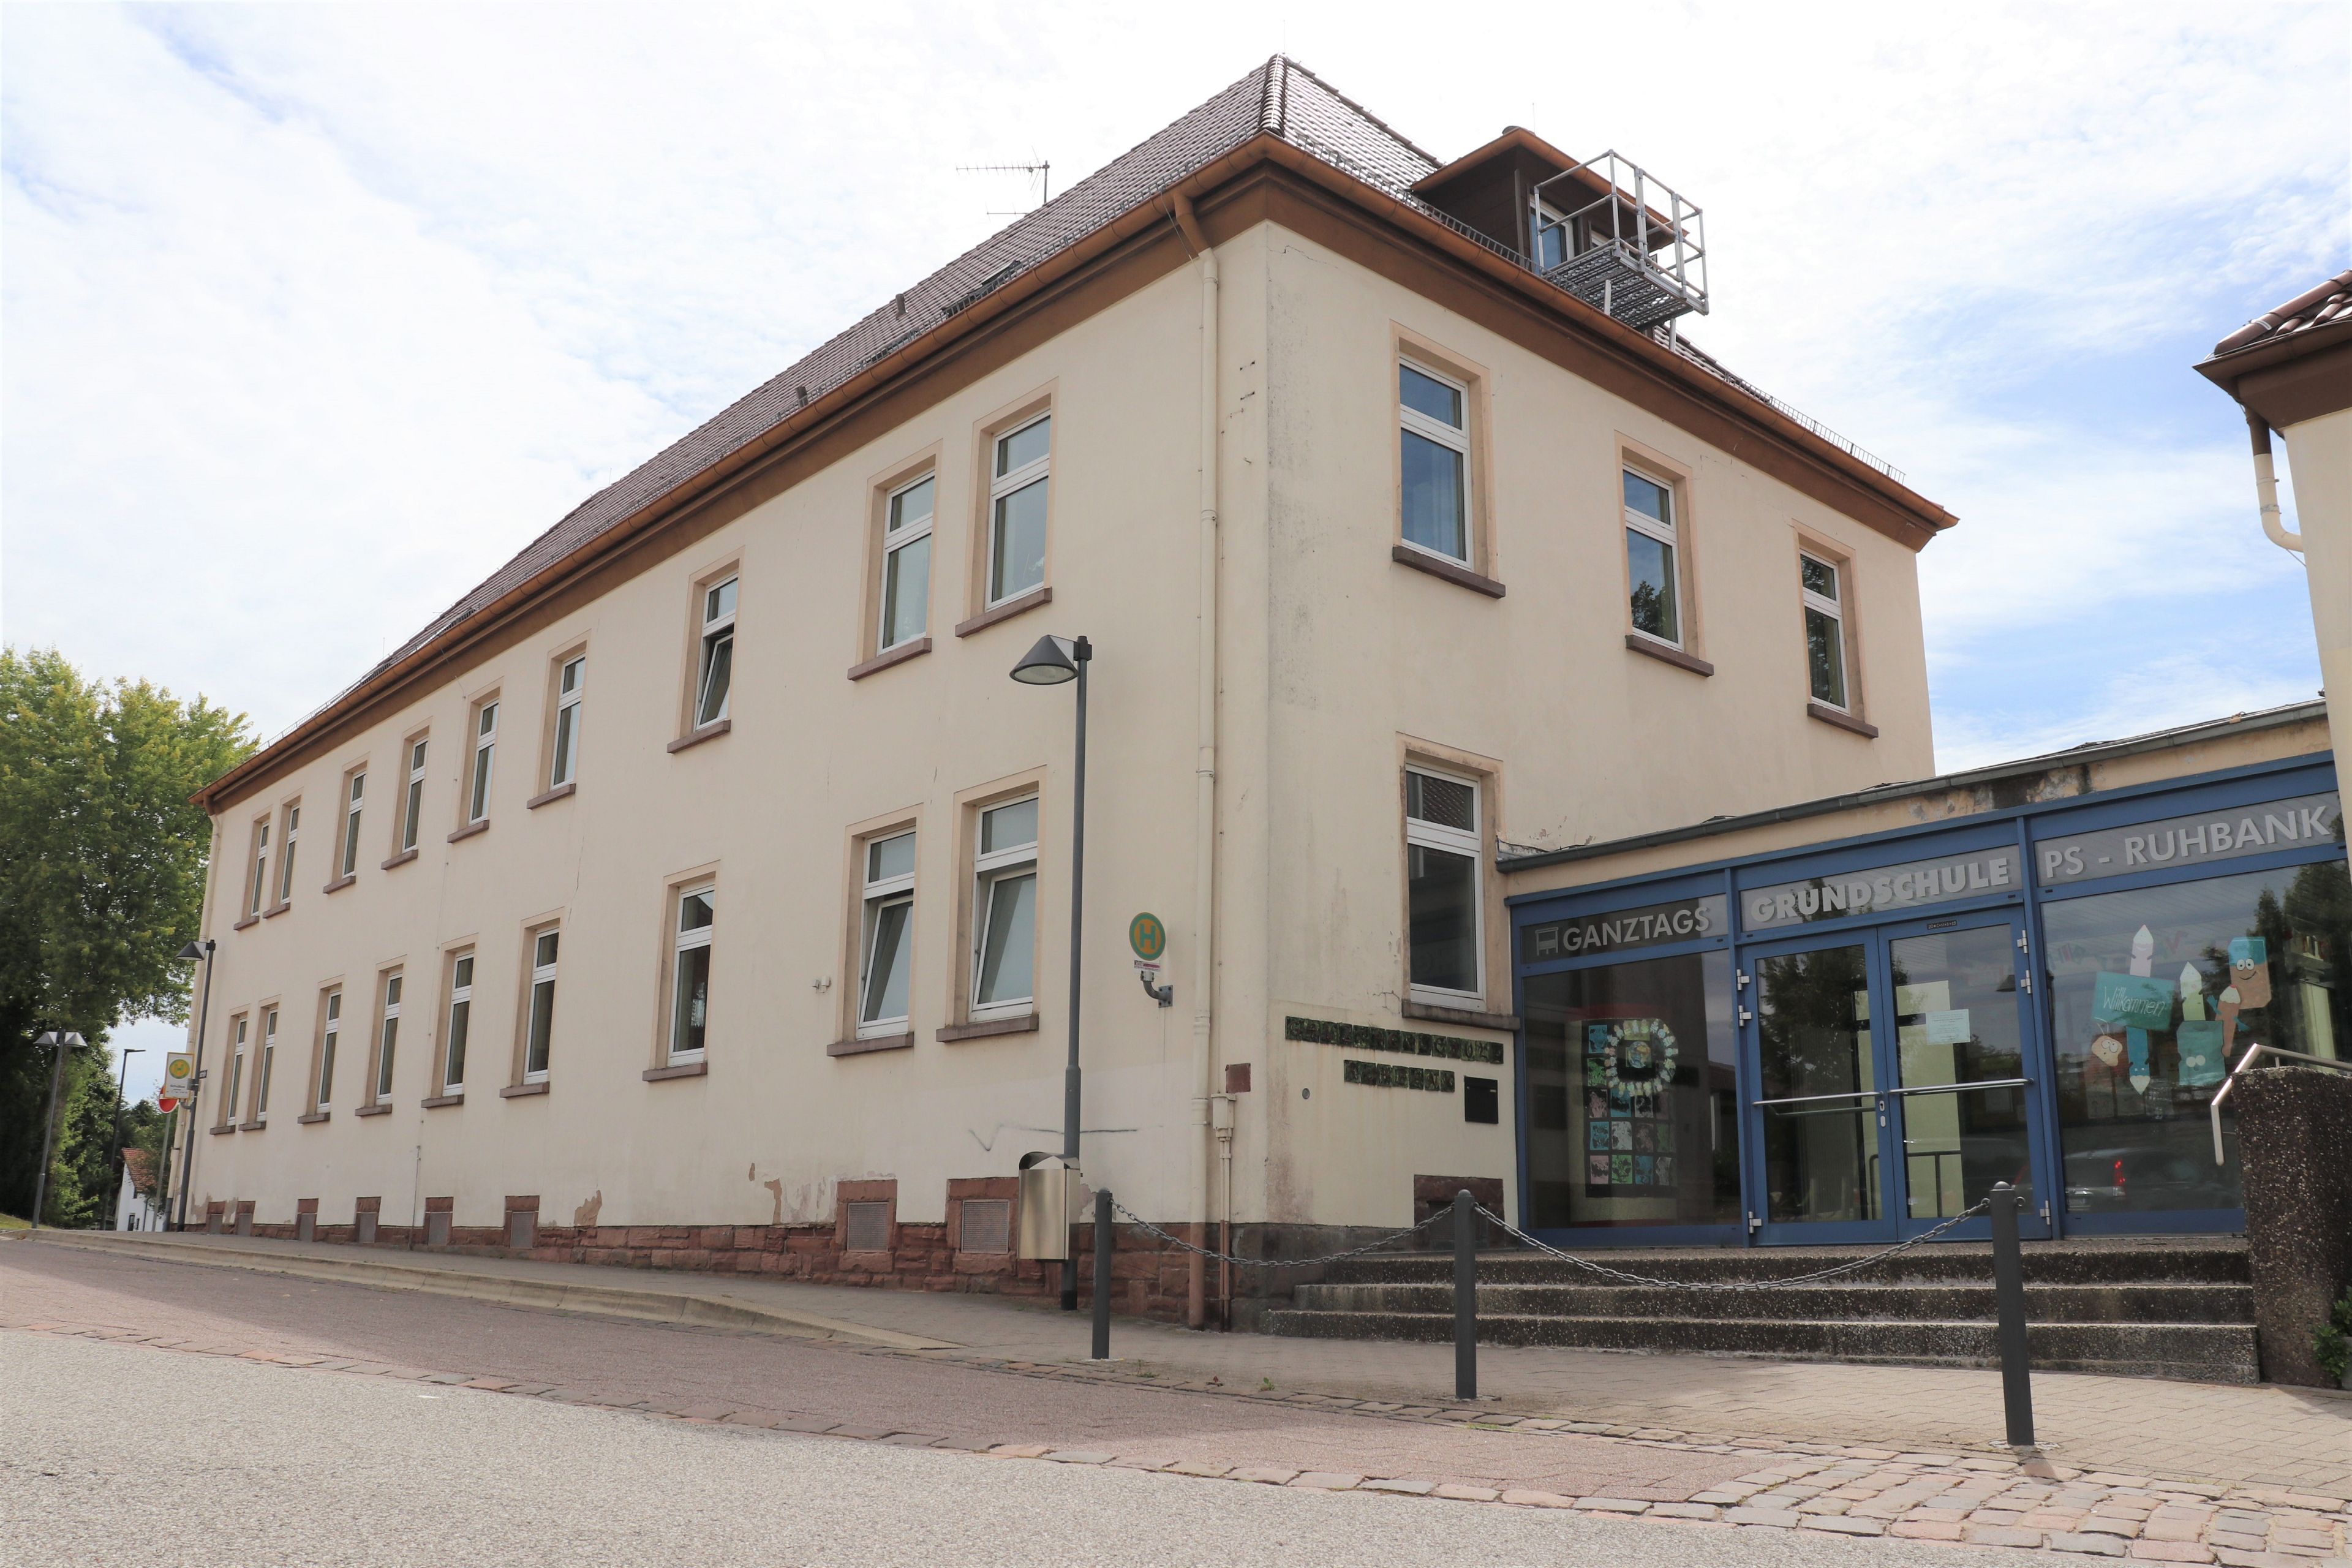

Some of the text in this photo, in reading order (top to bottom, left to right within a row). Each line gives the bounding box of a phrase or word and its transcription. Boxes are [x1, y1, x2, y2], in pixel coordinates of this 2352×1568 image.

[1563, 907, 1709, 951] GANZTAGS
[1751, 858, 2009, 922] GRUNDSCHULE
[2045, 846, 2084, 878] PS
[2125, 806, 2329, 865] RUHBANK
[1139, 924, 1156, 949] H
[2103, 986, 2166, 1017] Willkommen
